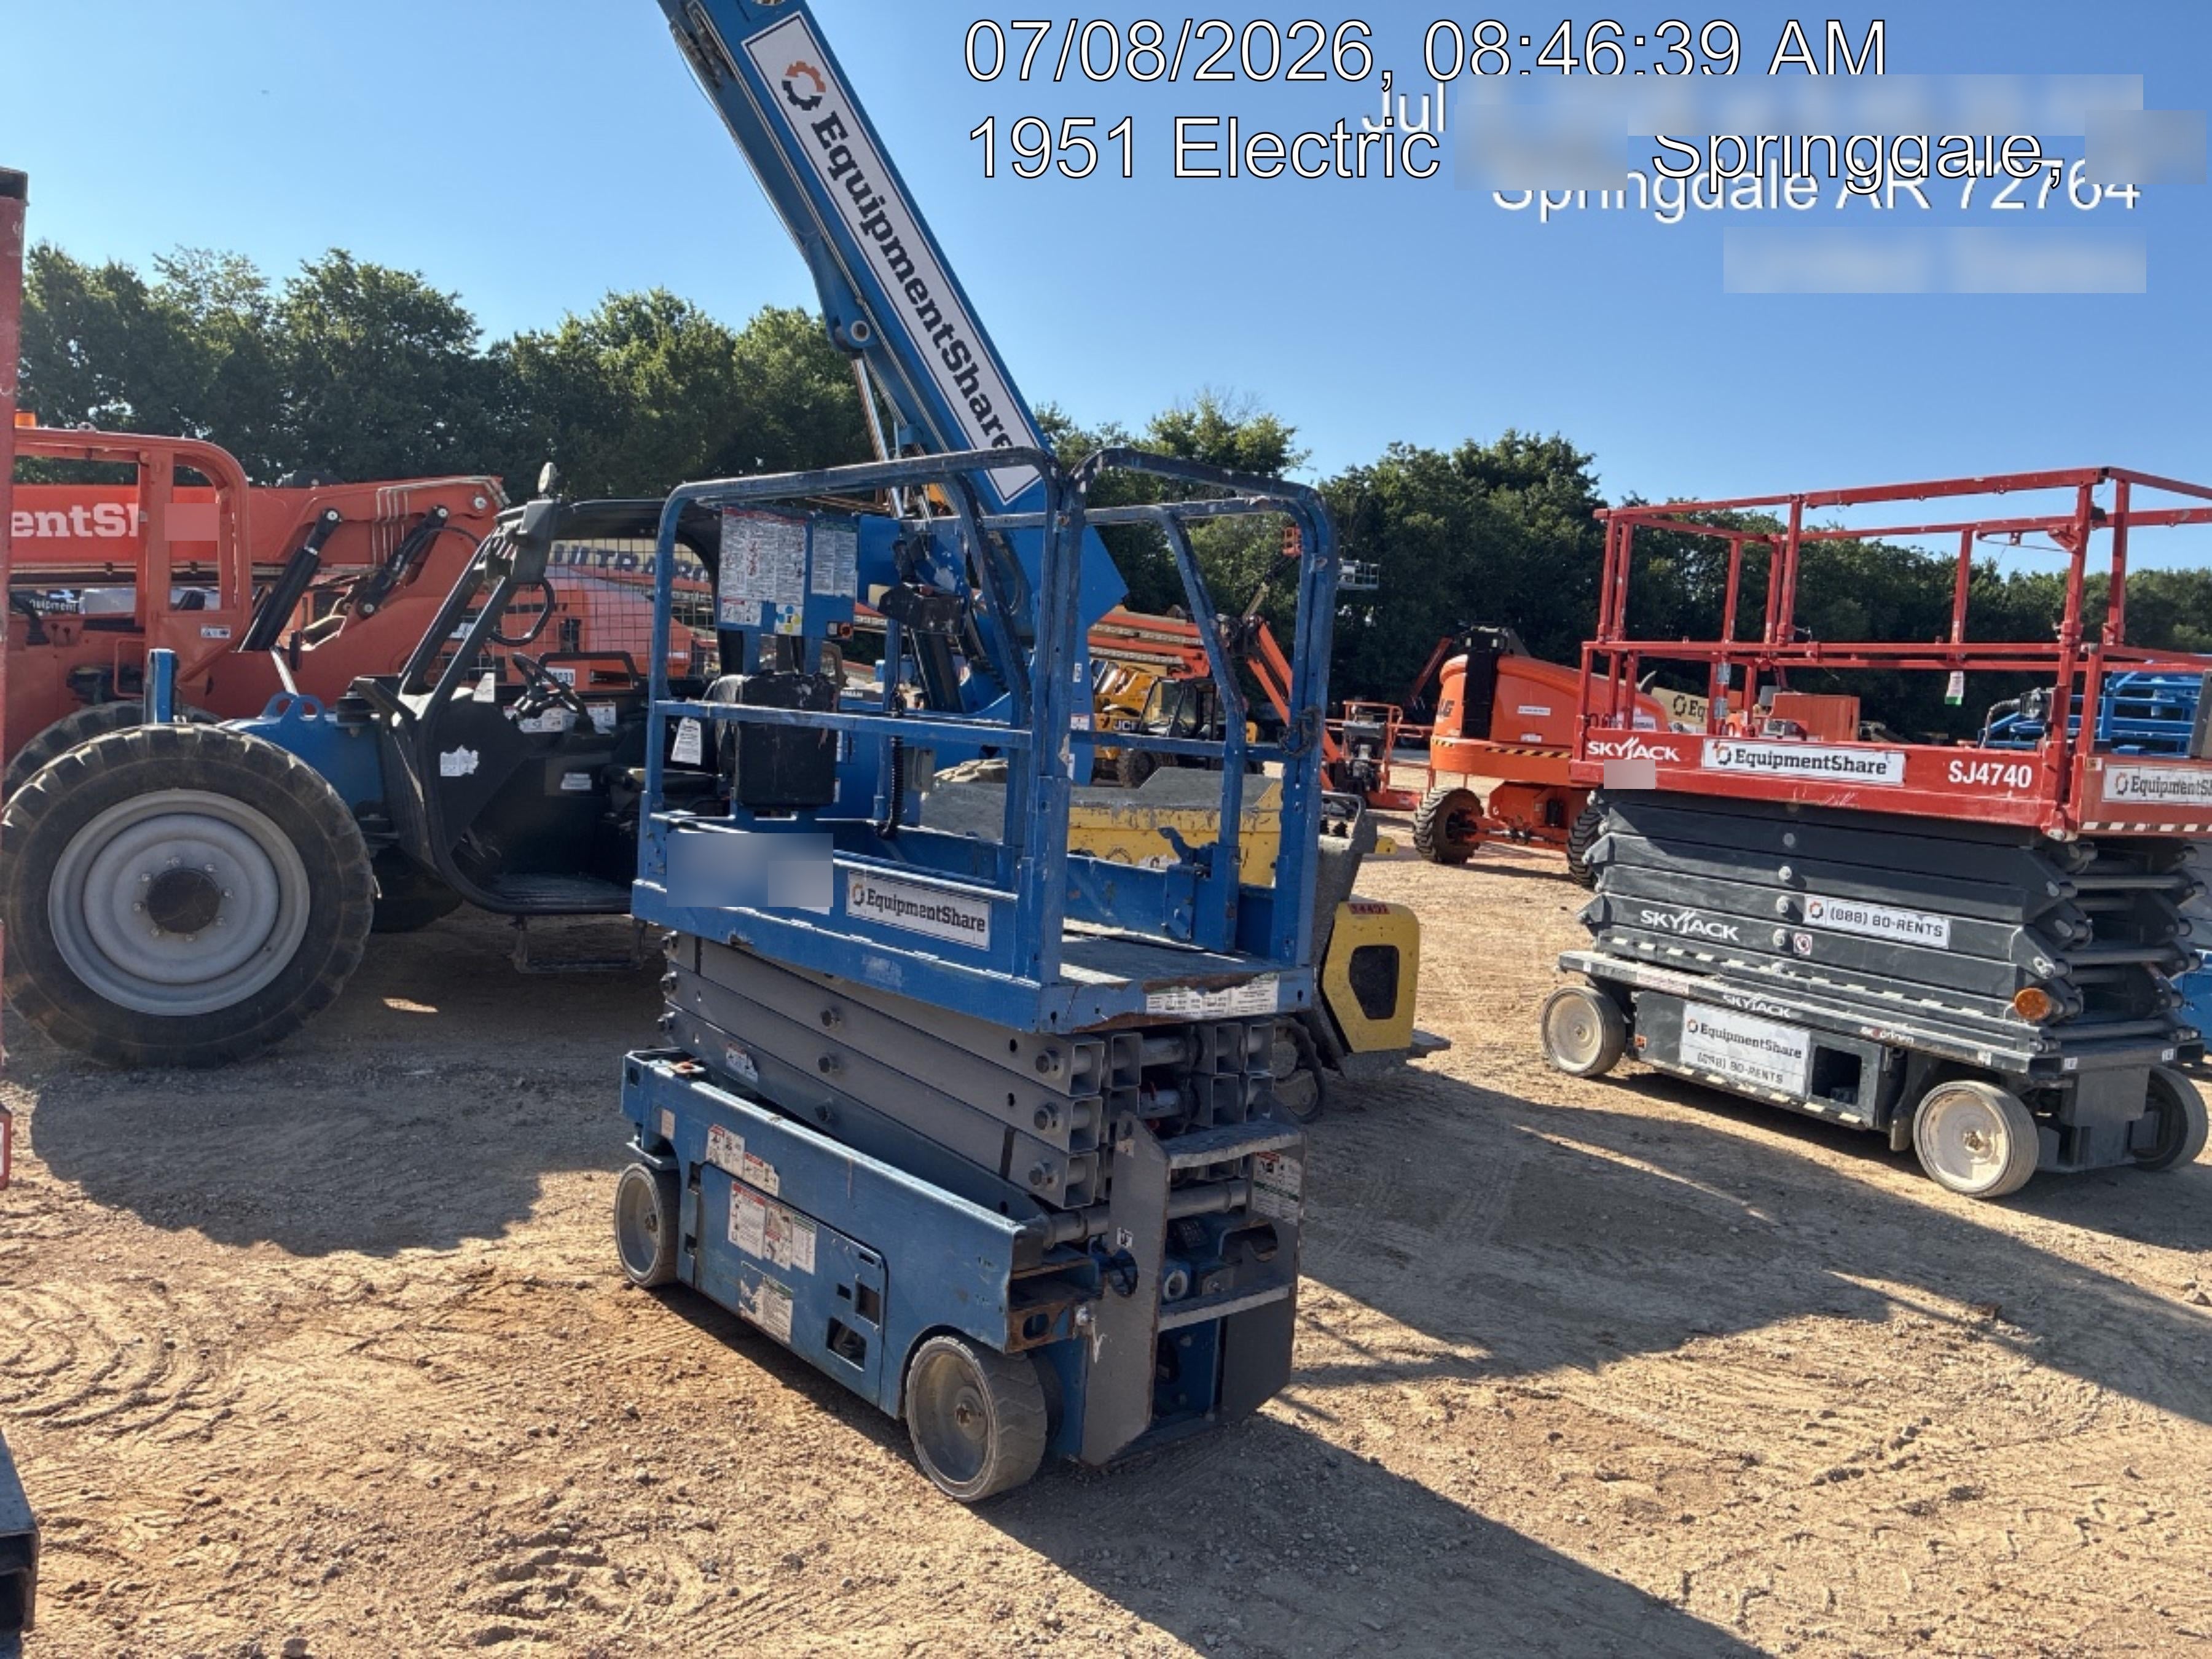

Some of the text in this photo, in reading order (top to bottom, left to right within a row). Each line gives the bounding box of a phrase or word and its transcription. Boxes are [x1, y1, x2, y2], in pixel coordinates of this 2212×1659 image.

[811, 111, 1014, 449] EquipmentShare
[1689, 700, 1706, 723] Eq
[1587, 735, 1681, 762] SKYJACK
[1735, 748, 1887, 775] EquipmentShare
[1948, 760, 2032, 788] SJ4740
[866, 888, 985, 932] EquipmentShare
[1640, 909, 1739, 941] SKYJACK
[1722, 993, 1792, 1018] SKYJACK
[1700, 1022, 1802, 1059] EquipmentShare
